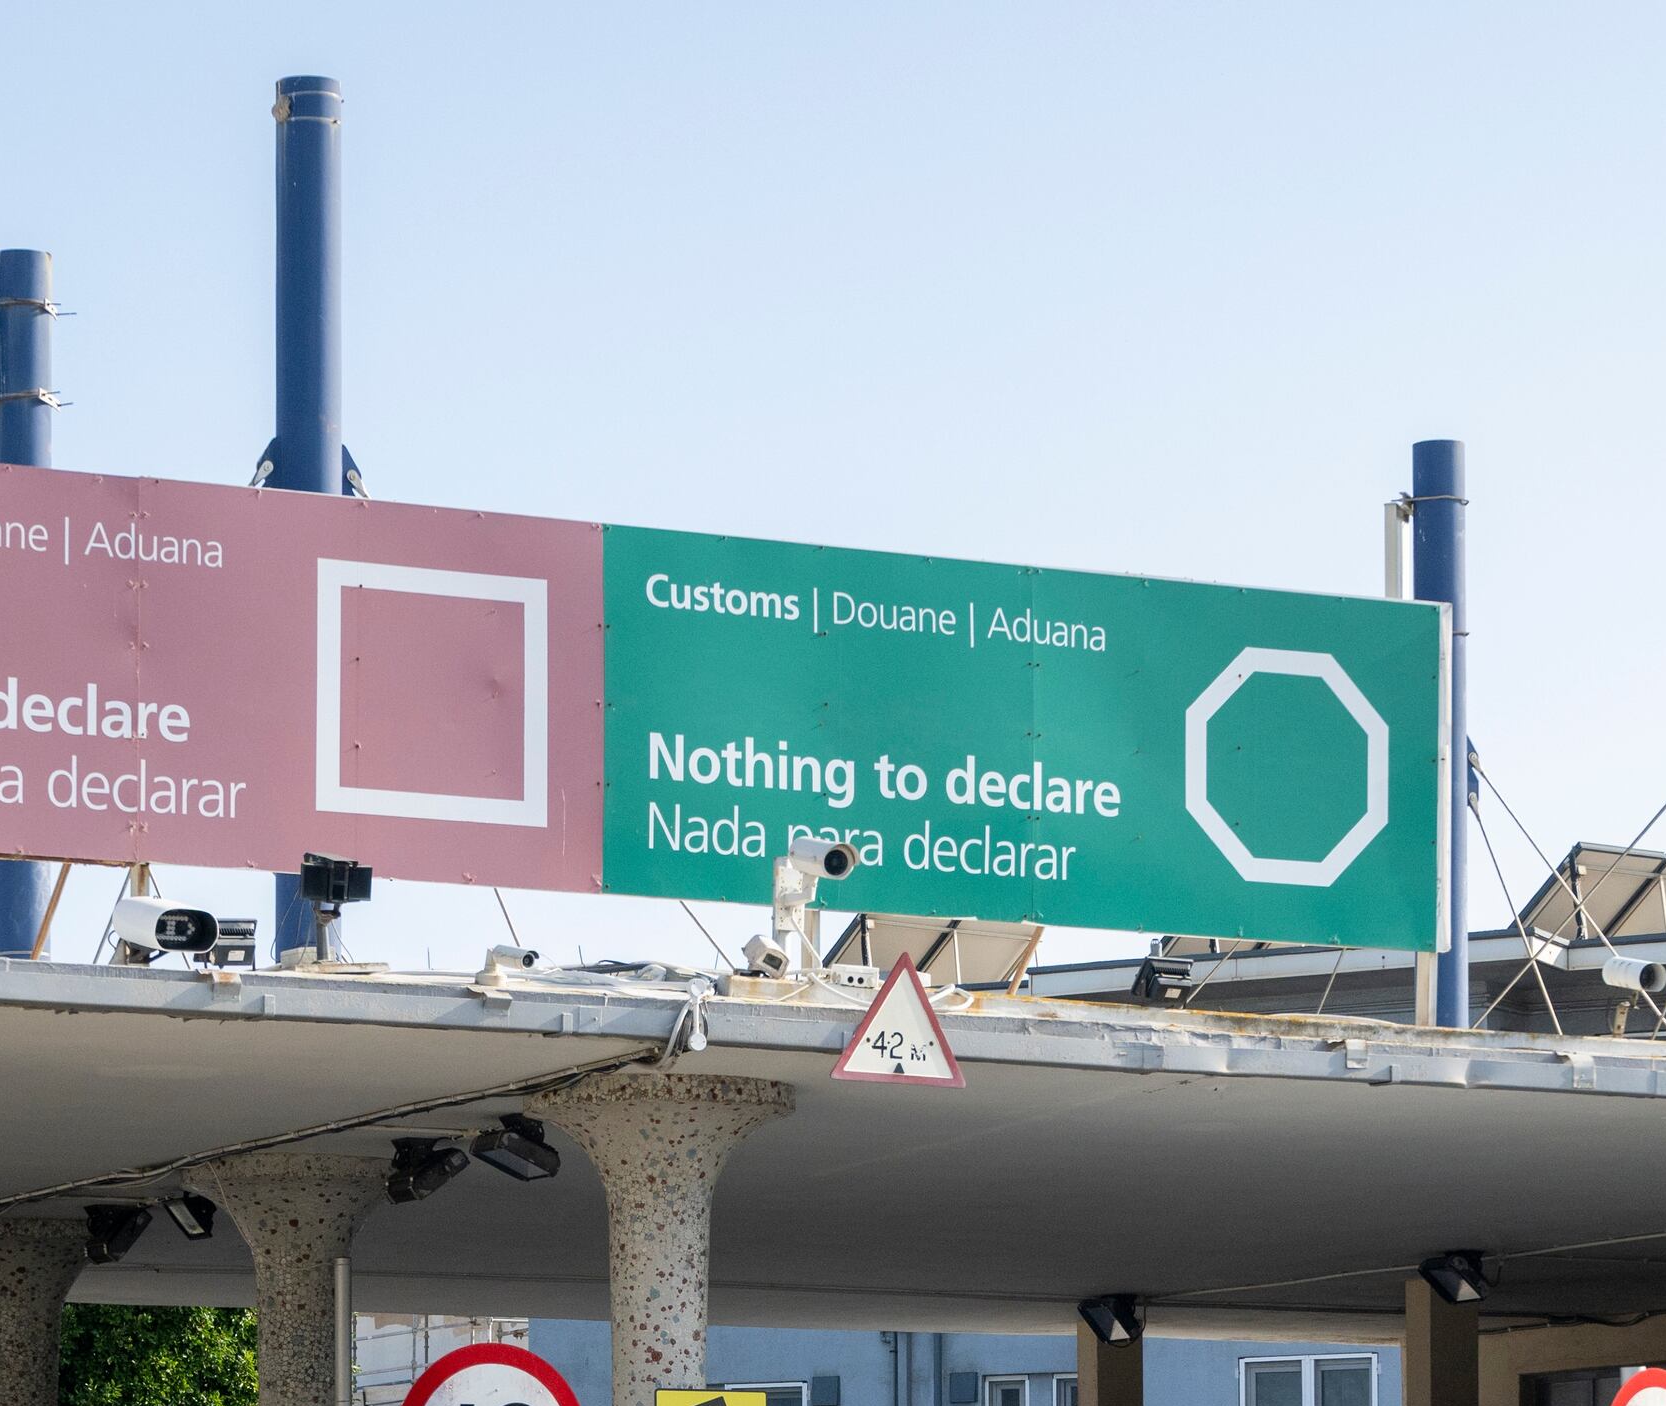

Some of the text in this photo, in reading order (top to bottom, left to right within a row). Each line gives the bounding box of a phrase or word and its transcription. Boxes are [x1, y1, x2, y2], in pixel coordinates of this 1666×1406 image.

[85, 520, 223, 569] Aduana
[646, 573, 1107, 652] Customs Douane Aduana
[47, 756, 247, 820] declarar
[648, 732, 1121, 818] Nothing to declare
[648, 801, 766, 858] Nada
[904, 822, 1076, 881] declarar
